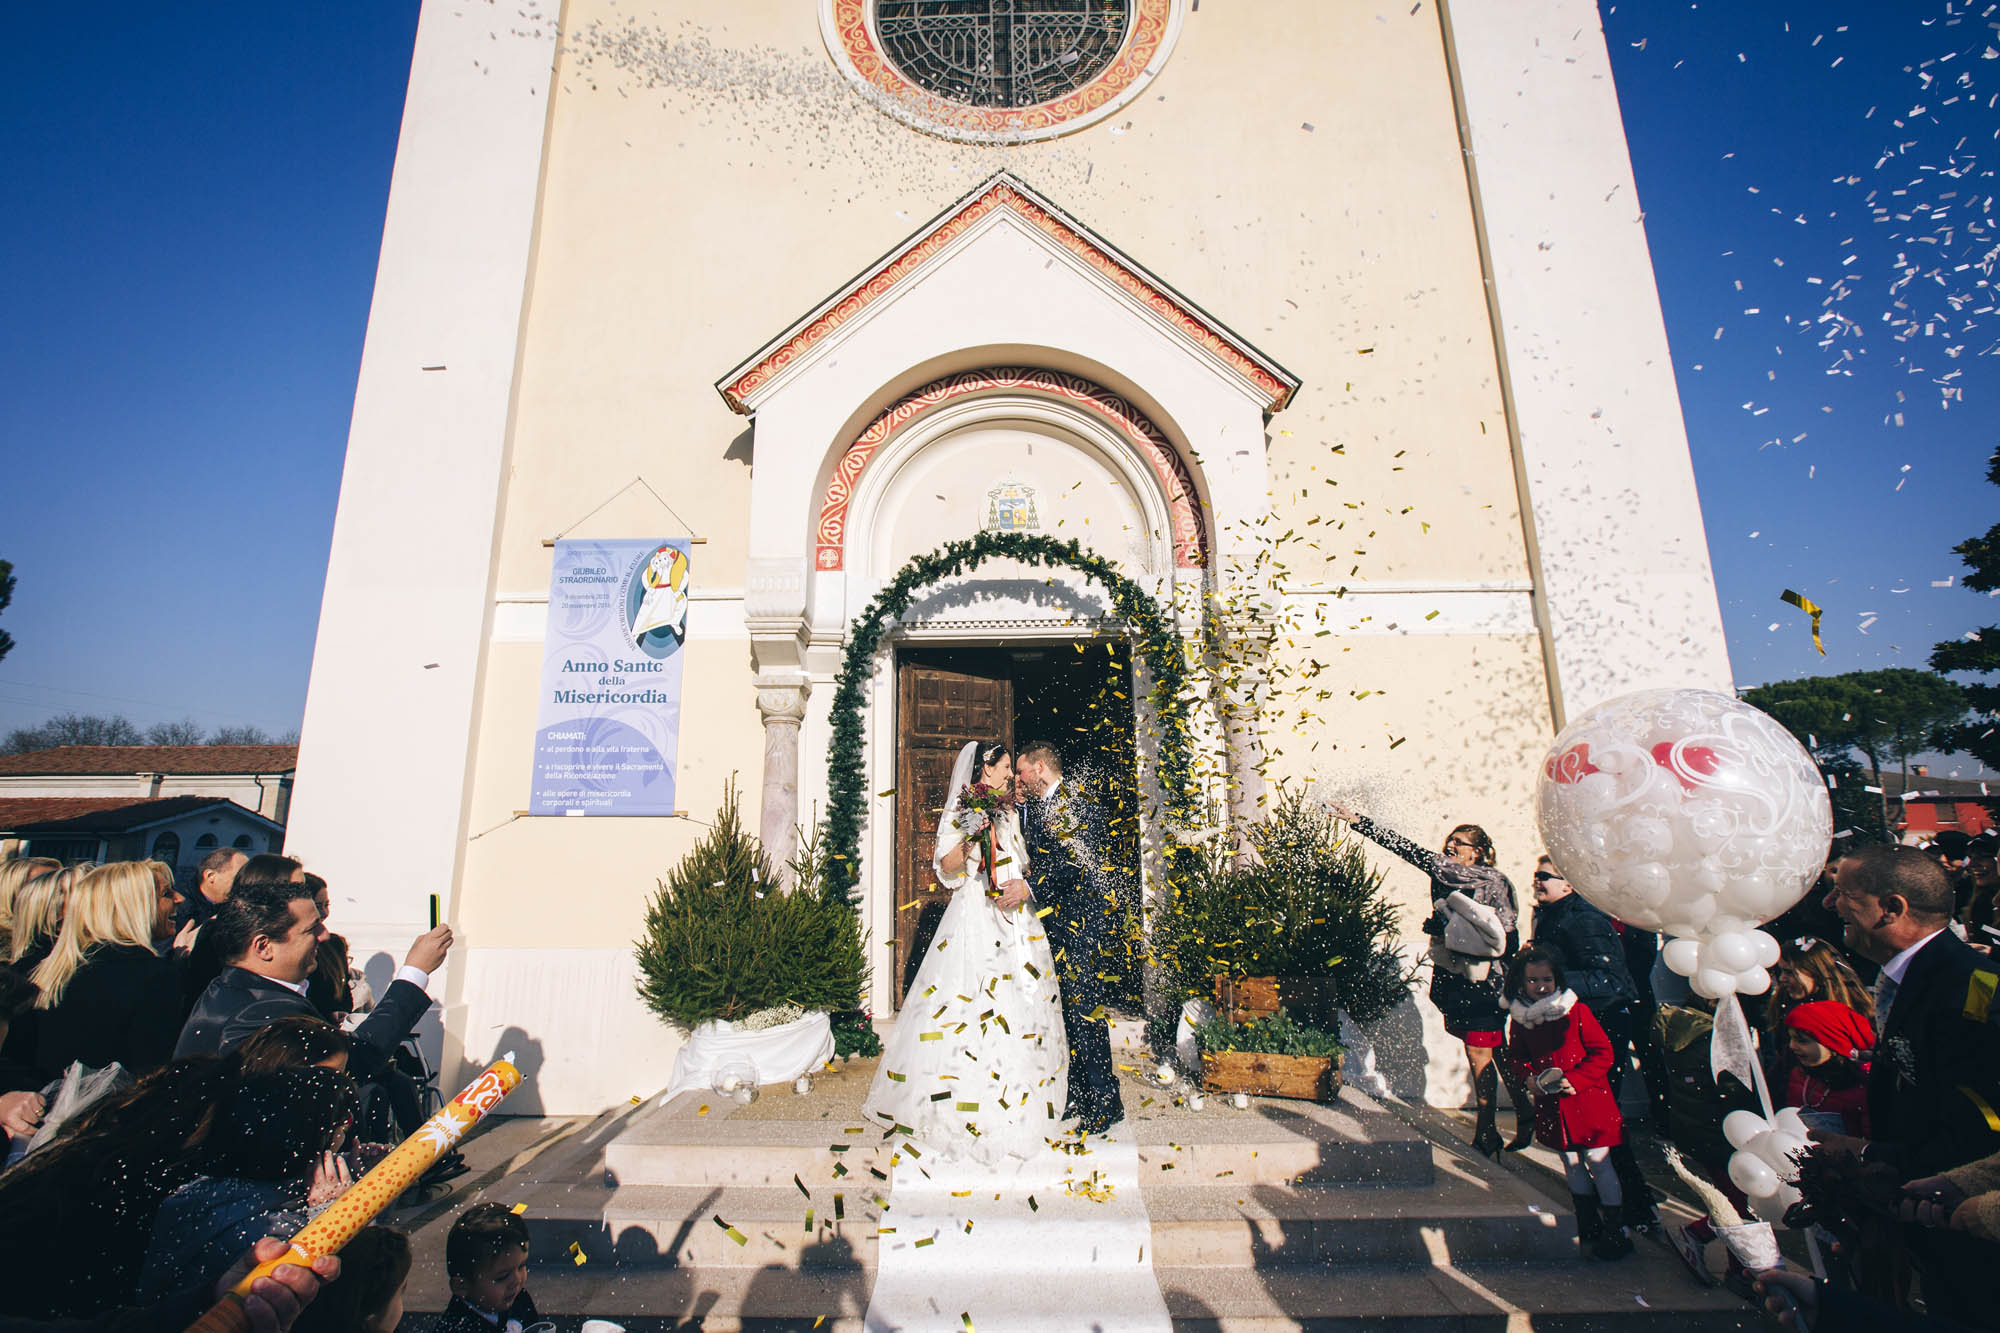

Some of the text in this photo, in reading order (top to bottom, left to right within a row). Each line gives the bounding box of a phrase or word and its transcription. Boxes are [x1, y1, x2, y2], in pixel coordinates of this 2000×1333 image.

[559, 576, 618, 584] STRAORDINARIO
[561, 659, 663, 673] Anno Santo
[598, 676, 625, 686] della
[553, 689, 667, 704] Misericordia
[555, 745, 584, 754] perdono
[592, 745, 605, 753] alla
[606, 745, 620, 753] vita
[621, 745, 649, 753] fraterna
[551, 763, 585, 772] riscoprire
[593, 763, 614, 771] vivere
[621, 763, 664, 771] Sacramento
[544, 772, 563, 780] della
[557, 790, 578, 799] opere
[579, 789, 585, 797] di
[543, 799, 574, 808] corporali
[581, 799, 613, 808] spirituali
[434, 1121, 454, 1140] gold
